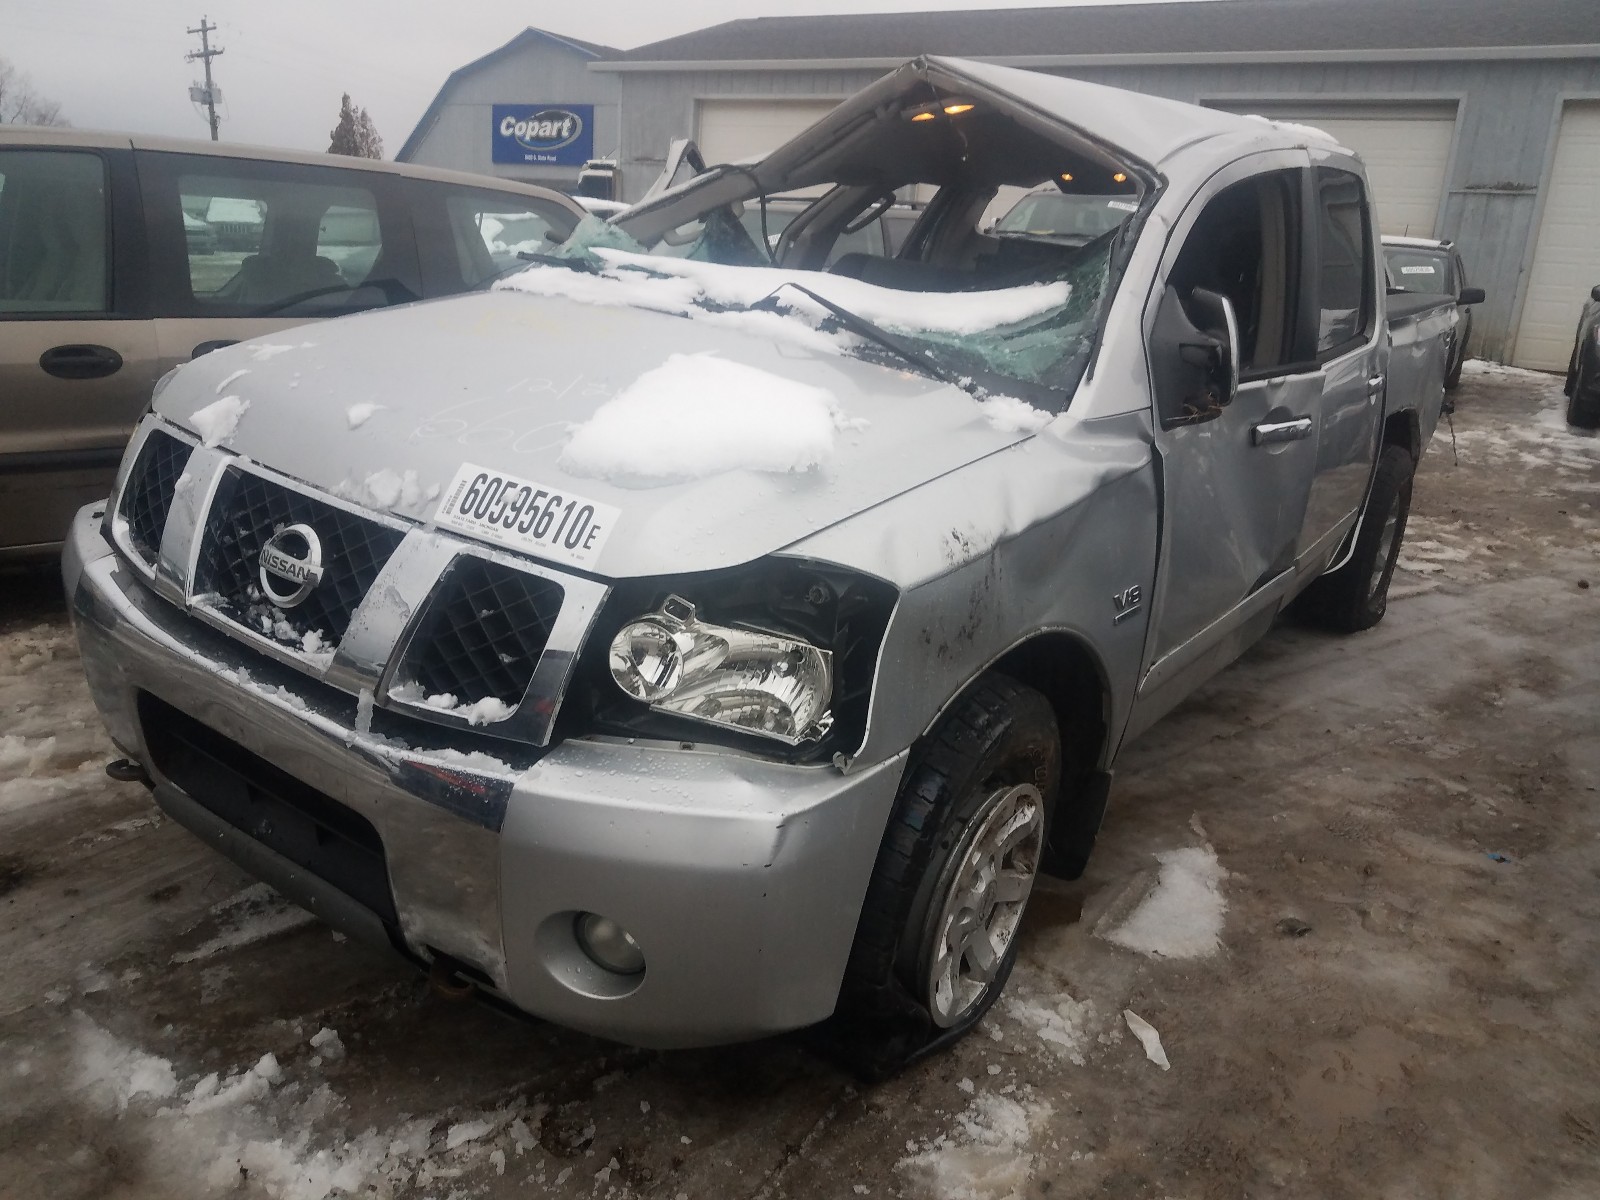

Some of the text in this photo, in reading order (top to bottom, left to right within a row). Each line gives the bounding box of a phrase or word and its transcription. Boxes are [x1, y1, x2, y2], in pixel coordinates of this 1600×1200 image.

[500, 116, 571, 141] Copart
[260, 549, 311, 581] NISSAN
[1112, 584, 1140, 610] V8
